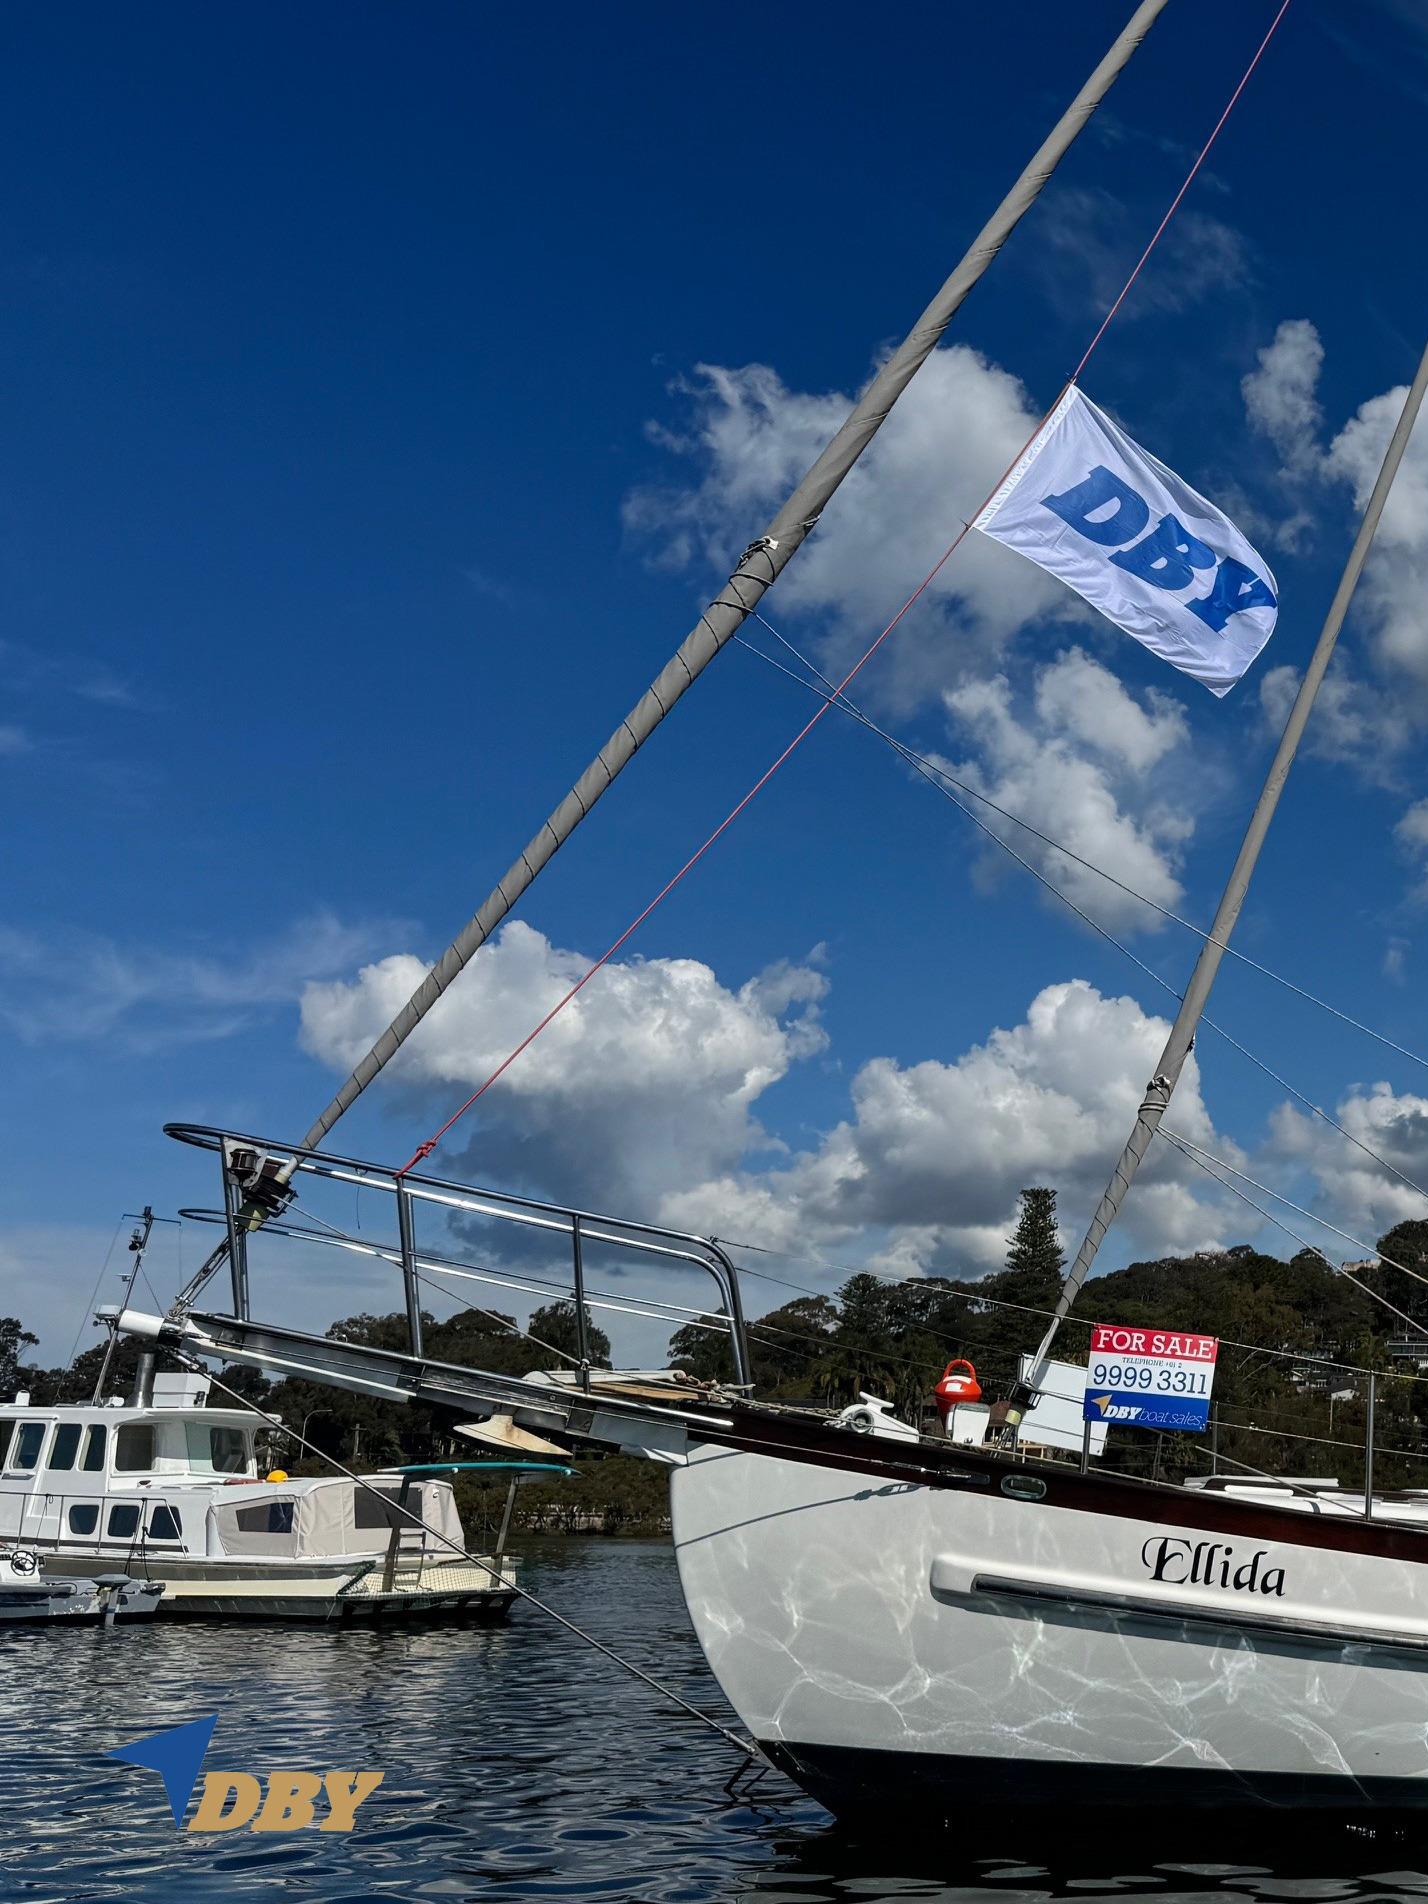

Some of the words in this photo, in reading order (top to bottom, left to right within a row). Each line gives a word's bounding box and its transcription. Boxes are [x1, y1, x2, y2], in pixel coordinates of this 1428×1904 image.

[1040, 465, 1278, 633] DBY
[1097, 1329, 1145, 1352] FOR
[1152, 1334, 1213, 1359] SALE
[1122, 1356, 1164, 1367] TELEPHONE
[1093, 1364, 1152, 1389] 9999
[1157, 1370, 1206, 1395] 3311
[1103, 1404, 1142, 1419] DBY
[1138, 1407, 1169, 1423] boat
[1169, 1411, 1202, 1426] sales
[1141, 1536, 1286, 1597] Ellida
